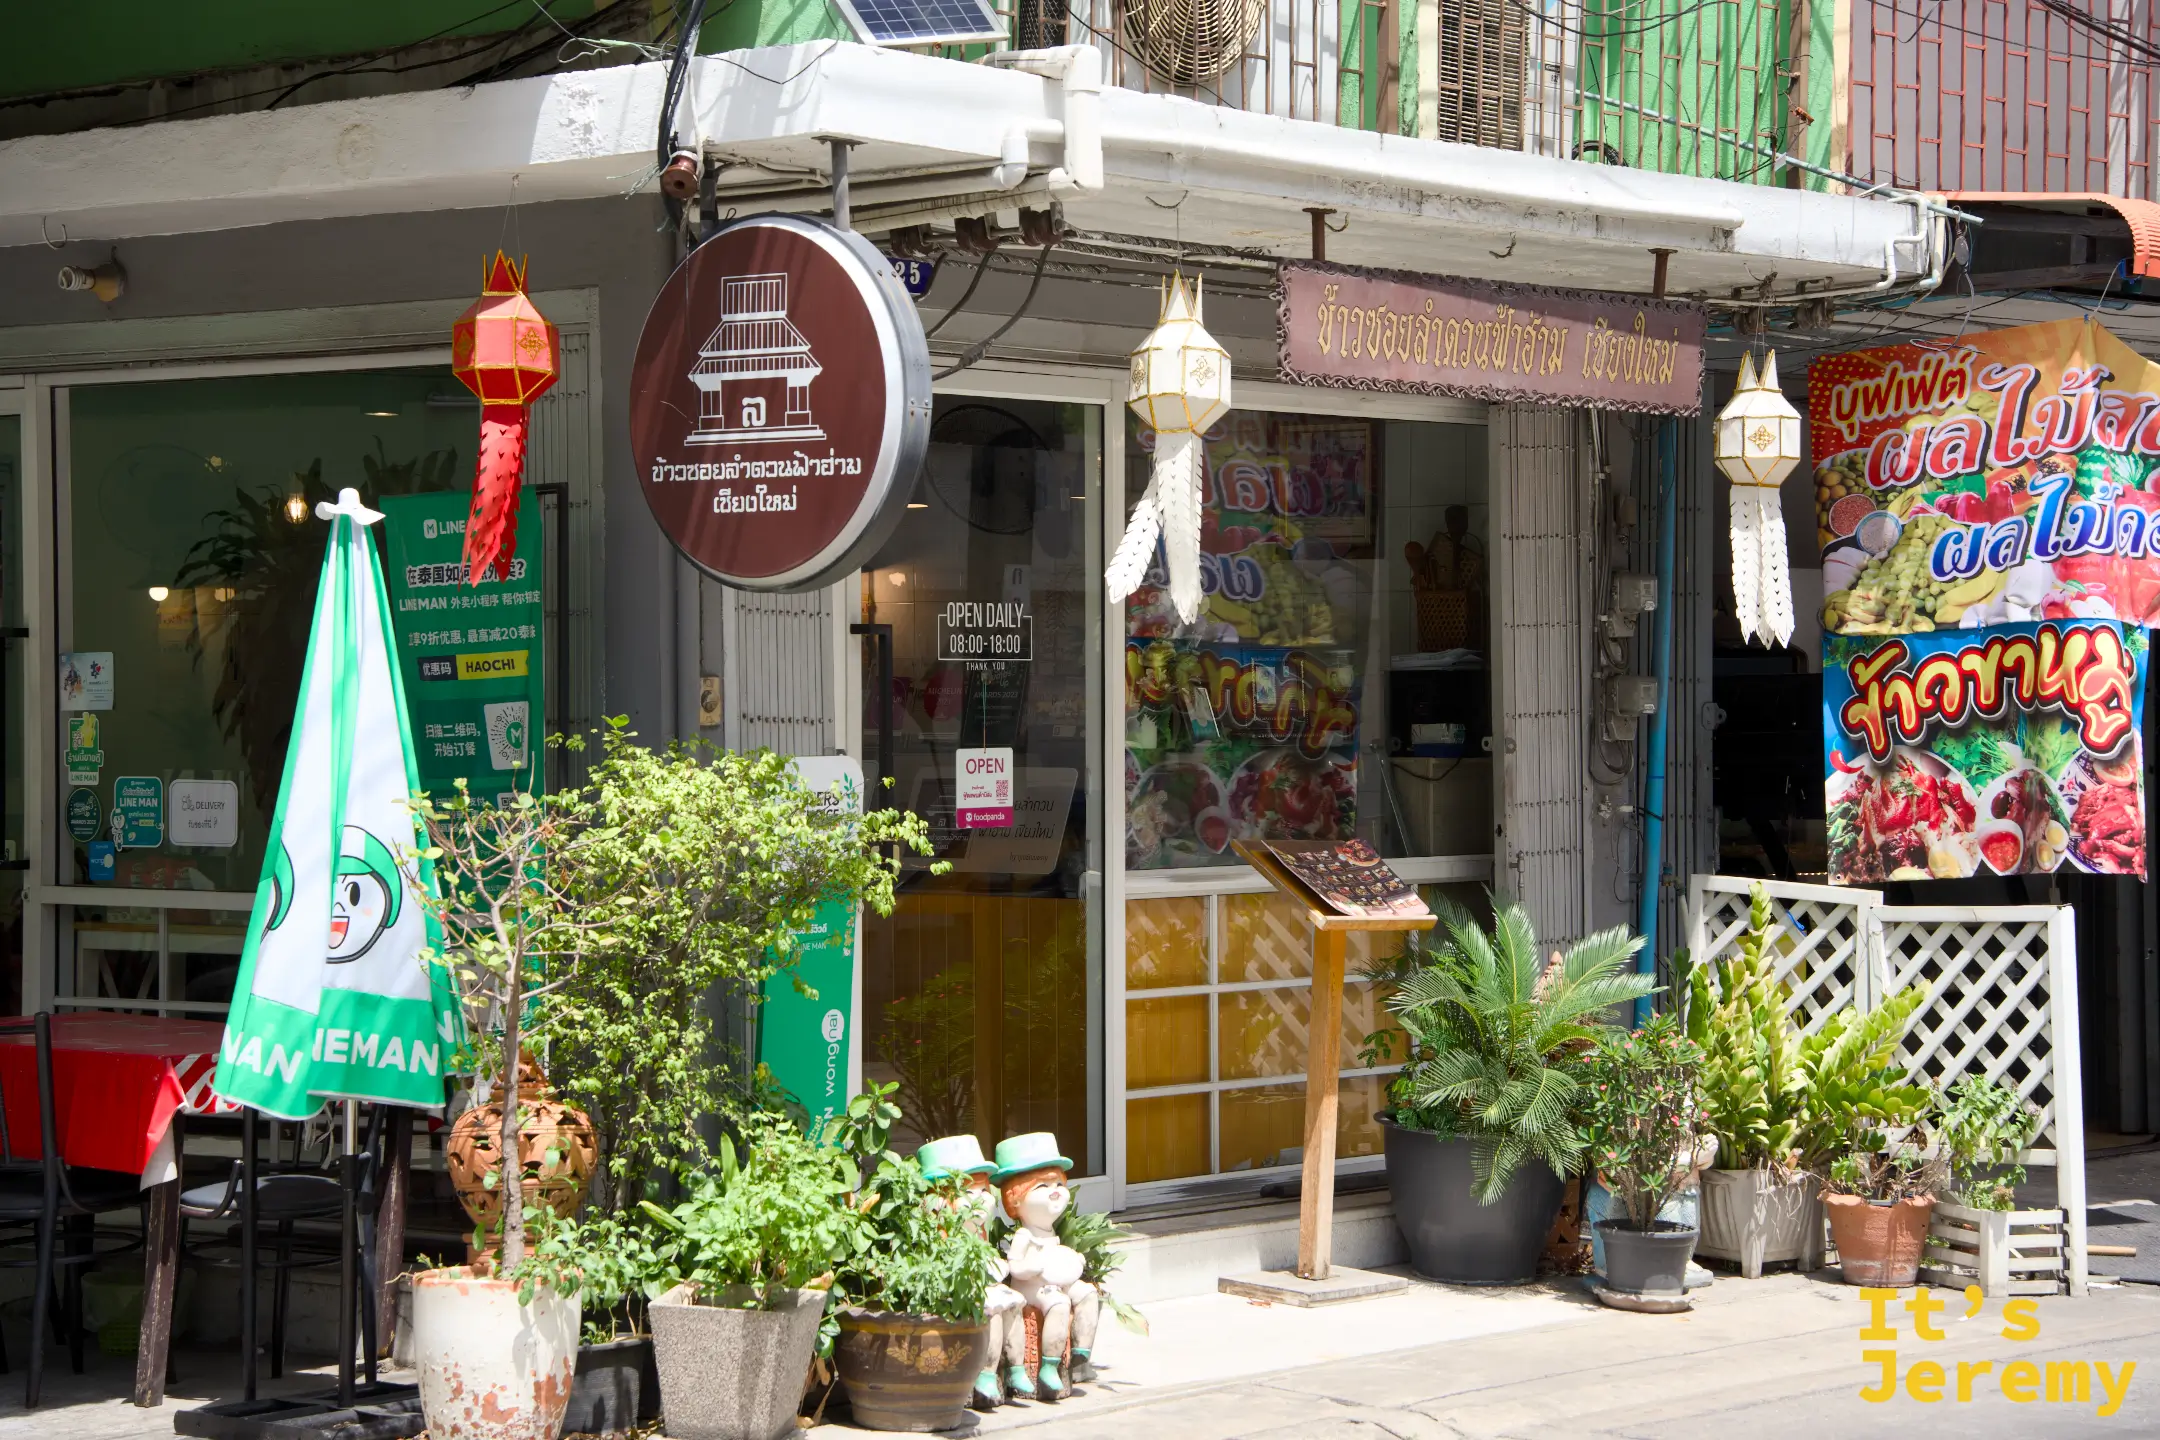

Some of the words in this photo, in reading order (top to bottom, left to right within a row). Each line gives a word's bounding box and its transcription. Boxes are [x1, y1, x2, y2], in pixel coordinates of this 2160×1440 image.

[1317, 284, 1569, 377] ข้าวซอยลำดวนฟ้าฮ่าม
[1582, 311, 1680, 385] เชียงใหม่
[1832, 348, 1975, 440] บุฟเฟ่ต์
[652, 448, 862, 482] ข้าวซอยลำดวนฟ้าฮ่าม
[713, 484, 797, 513] เชียงใหม่
[947, 602, 983, 628] OPEN
[986, 602, 1025, 628] DAILY
[950, 634, 1021, 654] 08:00-18:00
[466, 658, 516, 673] HAOCHI
[966, 662, 988, 671] THANK
[992, 662, 1006, 671] YOU
[1840, 624, 2135, 764] ข้าวขาหมู
[435, 742, 476, 757] 开始订餐
[966, 758, 1005, 774] OPEN
[119, 798, 137, 807] LINE
[138, 798, 158, 807] MAN
[196, 801, 225, 810] DELIVERY
[974, 812, 1005, 823] foodpanda
[825, 1013, 840, 1098] wongnai
